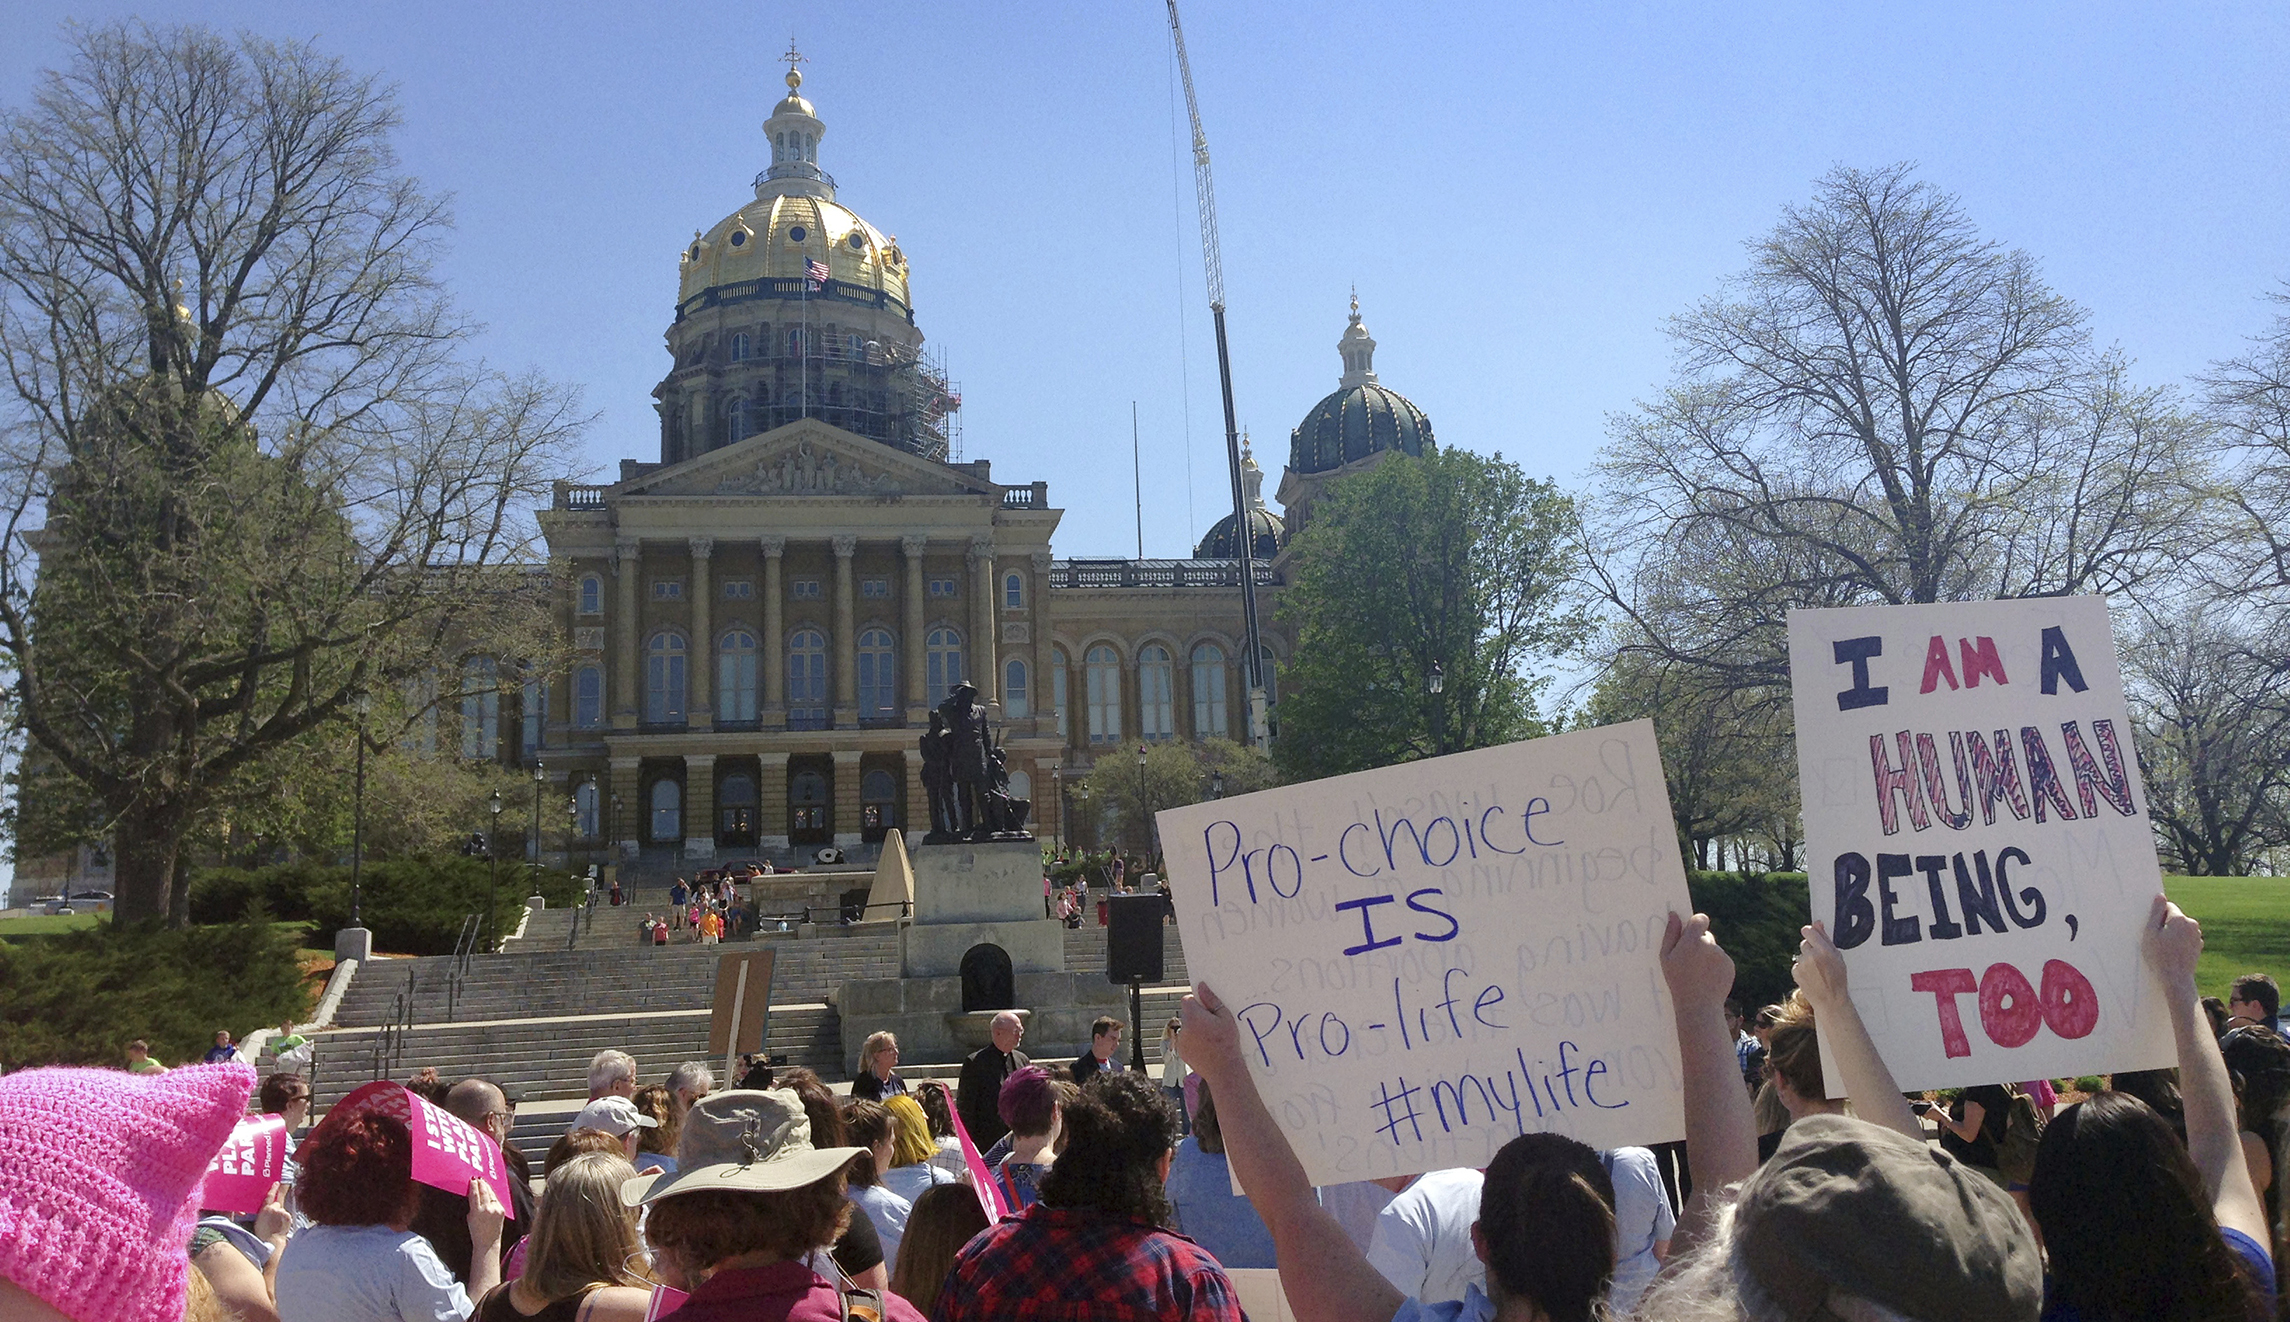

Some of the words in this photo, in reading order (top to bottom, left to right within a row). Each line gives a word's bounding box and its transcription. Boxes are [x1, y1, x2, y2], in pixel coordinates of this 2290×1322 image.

[1833, 636, 1889, 711] I
[1919, 635, 2009, 694] AM
[2040, 625, 2089, 696] A
[1869, 719, 2137, 836] HUMAN
[1203, 796, 1565, 907] Pro-choice
[1832, 846, 2079, 950] BEING,
[1334, 888, 1460, 957] IS
[1237, 967, 1511, 1067] Pro-life
[1911, 958, 2099, 1059] TOO
[1370, 1041, 1630, 1146] #mylife
